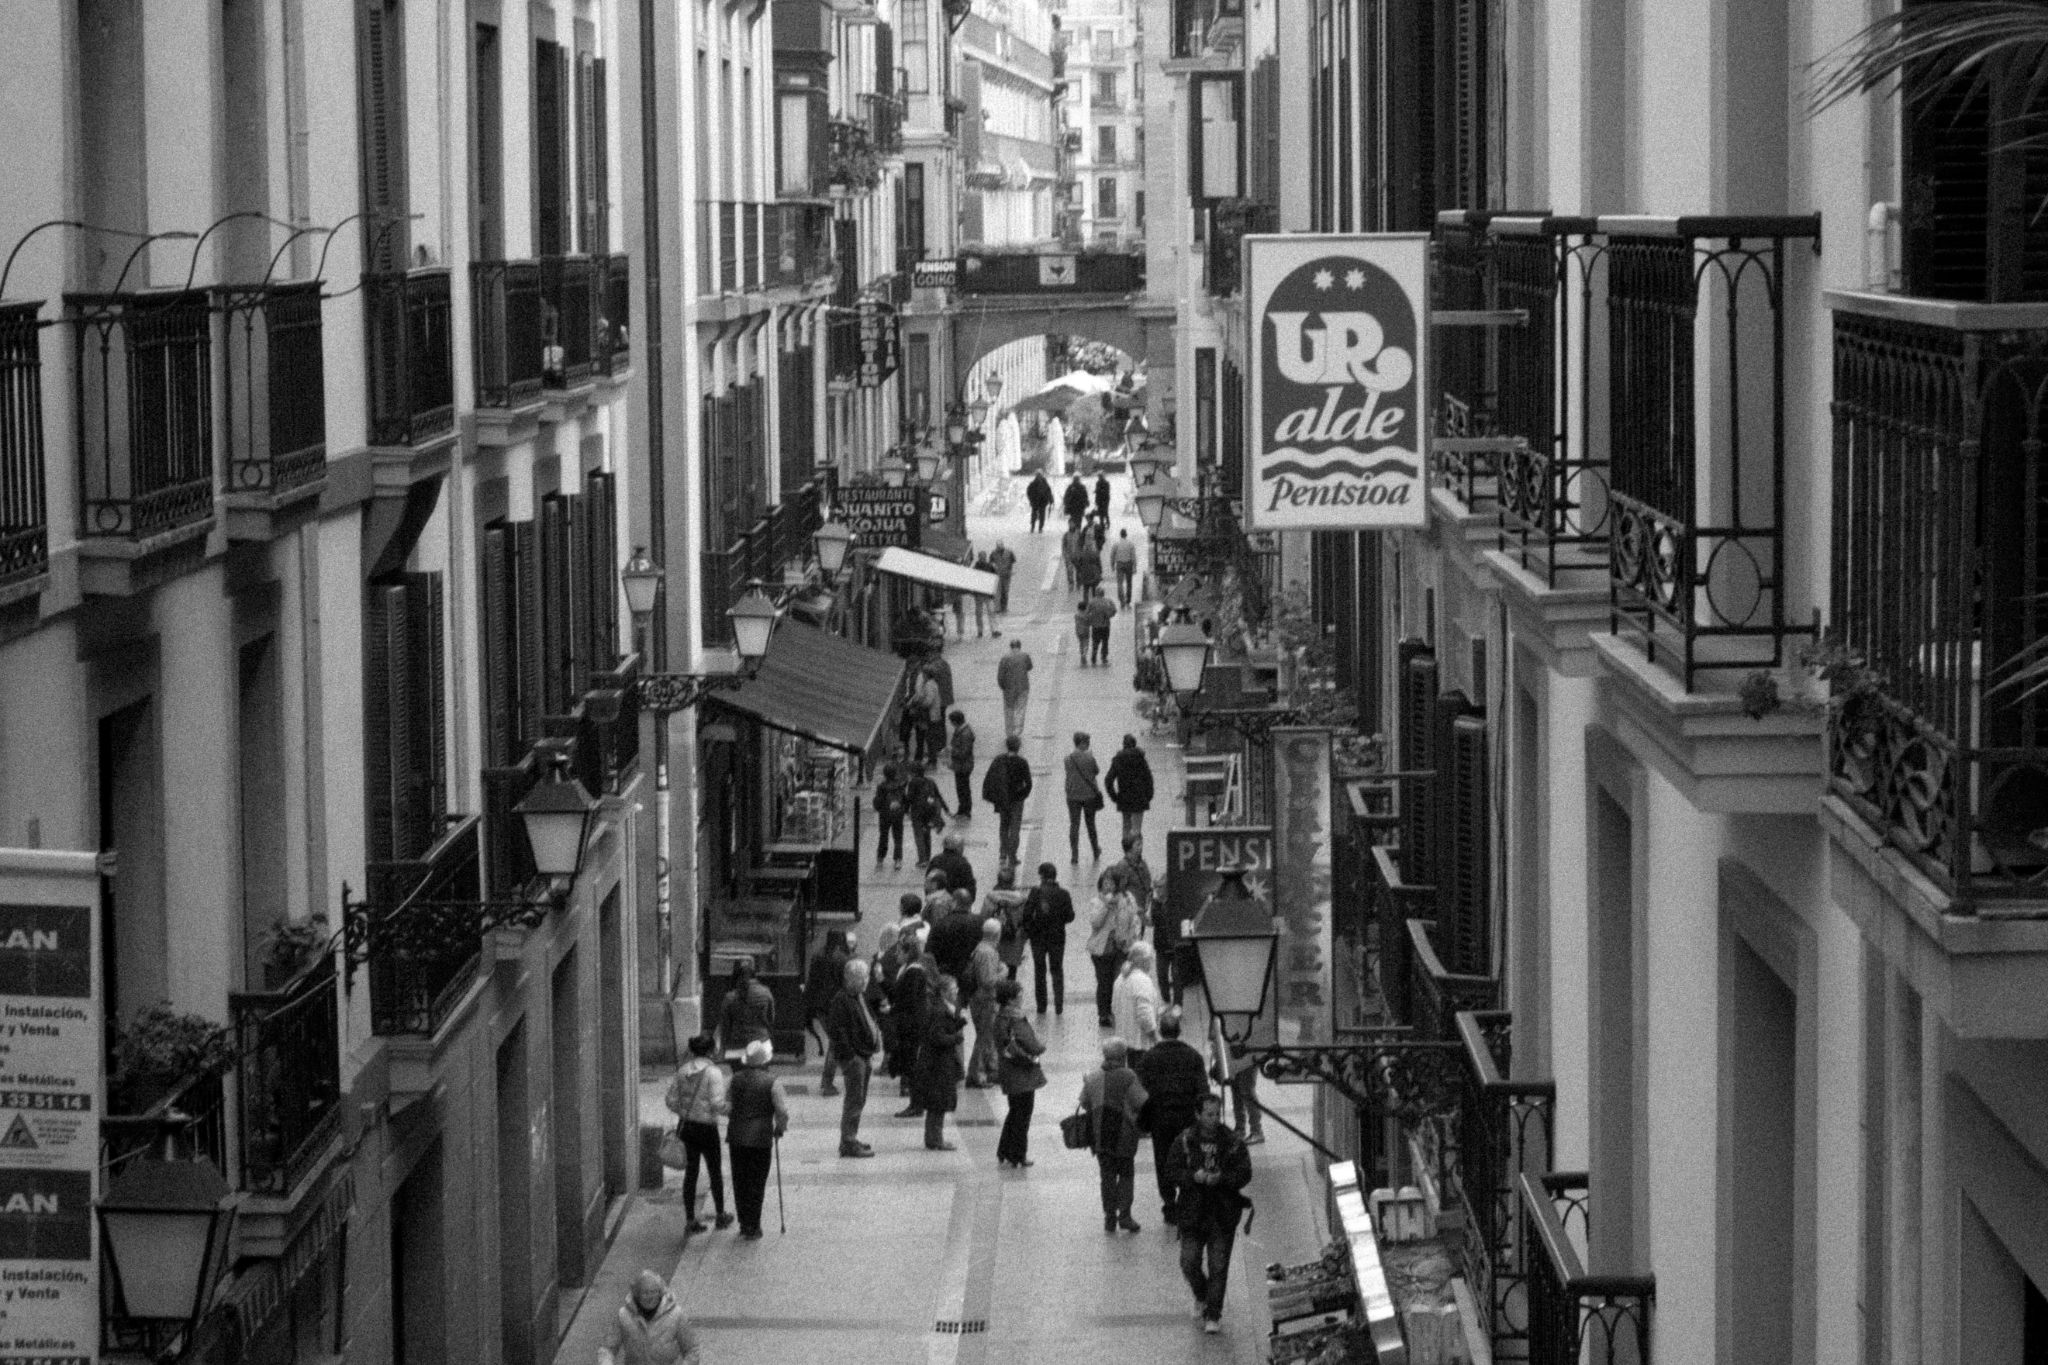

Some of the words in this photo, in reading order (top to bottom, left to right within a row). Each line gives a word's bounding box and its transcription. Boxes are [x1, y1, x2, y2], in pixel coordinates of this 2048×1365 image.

[1274, 387, 1406, 443] alde
[836, 488, 915, 502] RESTAURANTE
[1267, 471, 1411, 512] Pentsioa
[833, 502, 916, 517] JUANITO
[0, 928, 59, 951] AN
[20, 1023, 60, 1037] Venta
[0, 1192, 59, 1214] AN
[19, 1286, 60, 1300] Venta
